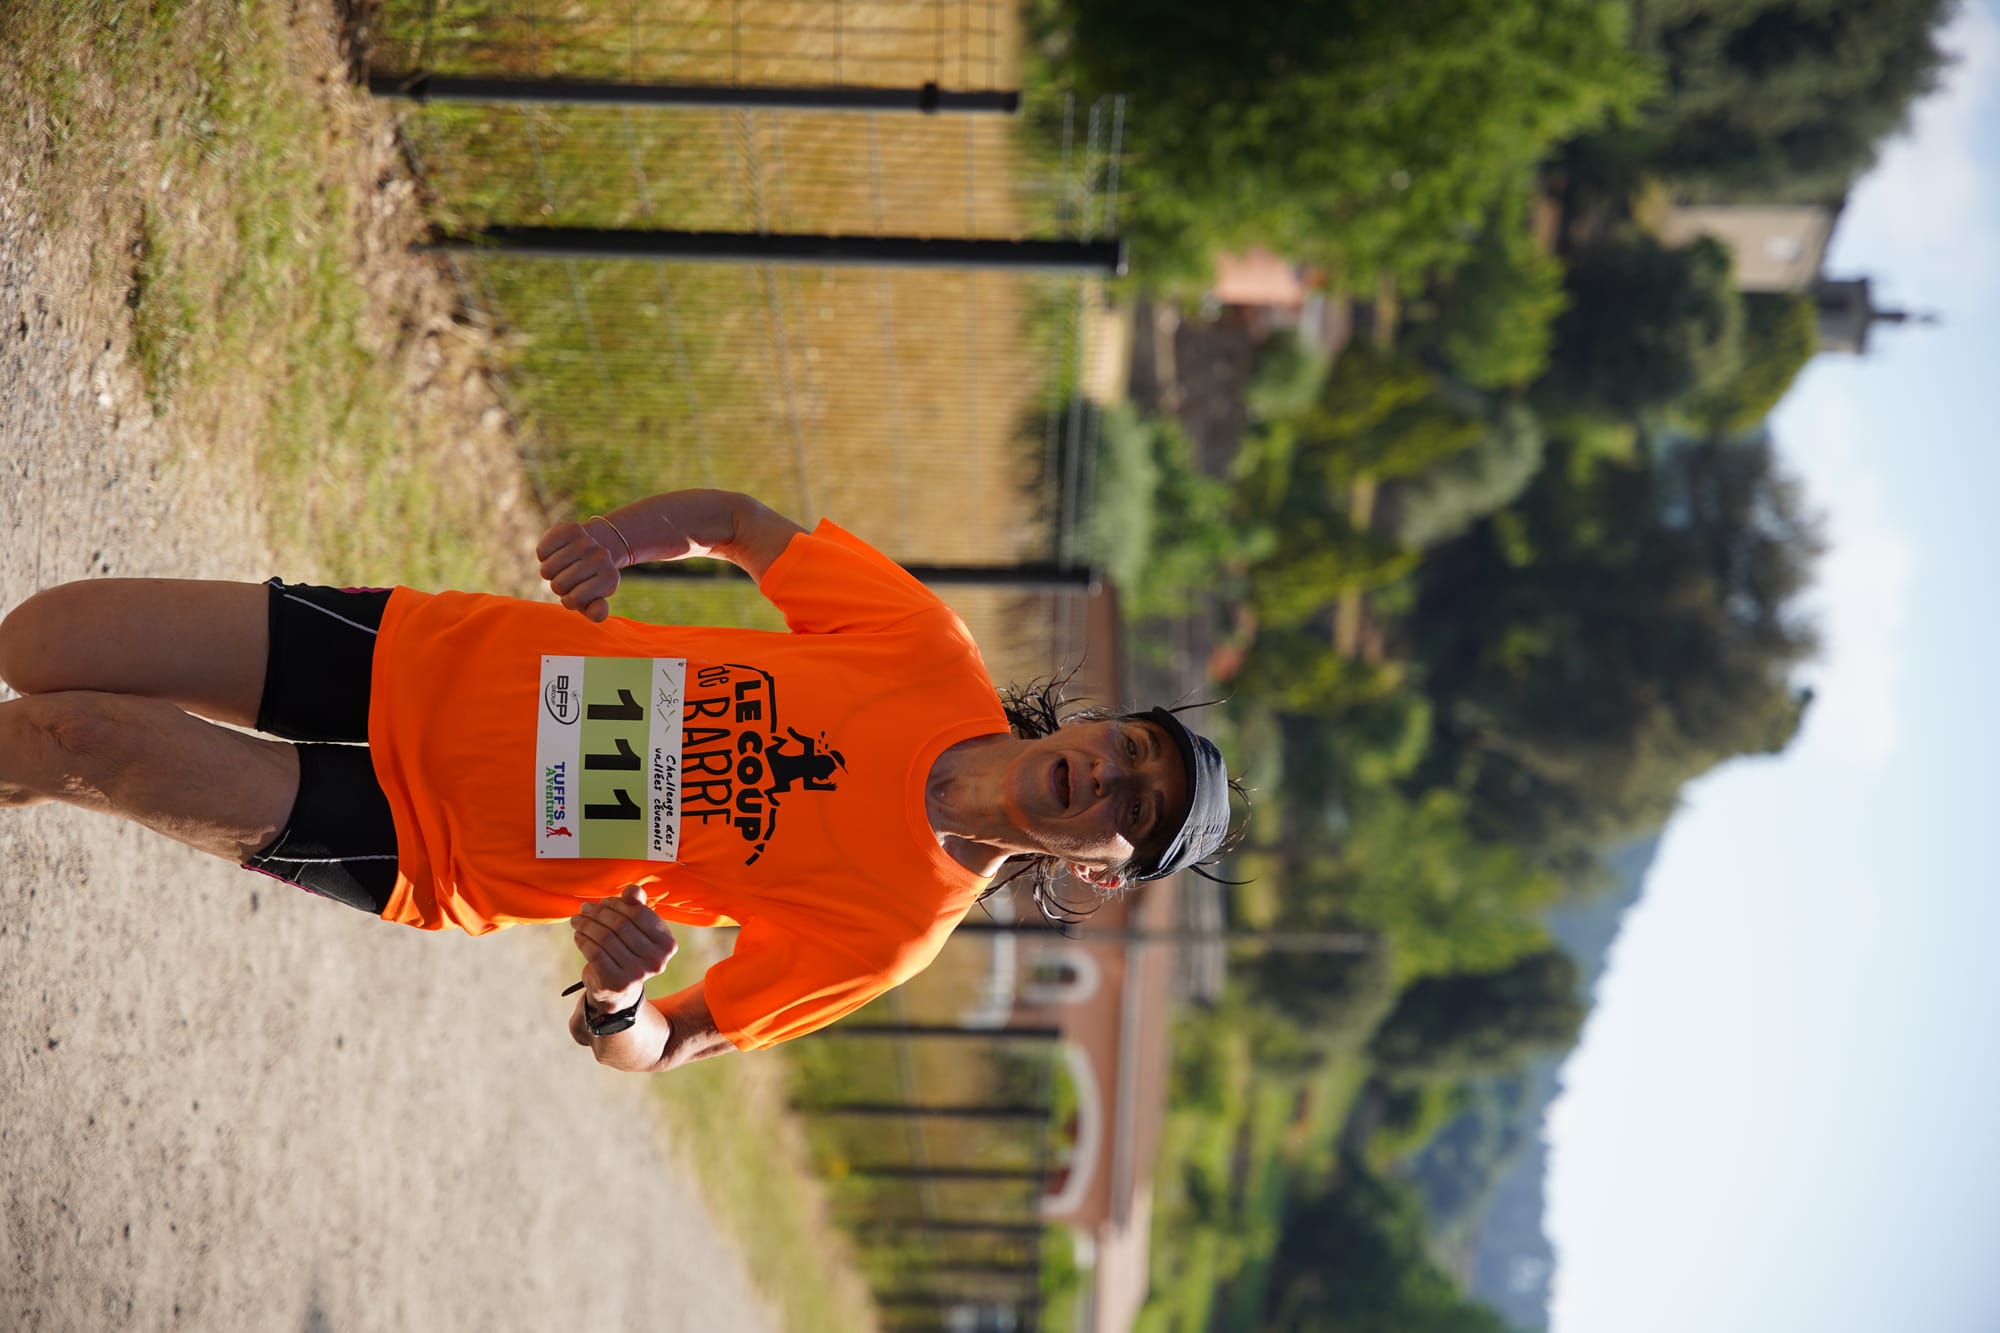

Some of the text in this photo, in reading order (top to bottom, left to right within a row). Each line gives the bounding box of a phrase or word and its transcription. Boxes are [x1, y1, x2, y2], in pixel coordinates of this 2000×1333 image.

[556, 675, 569, 718] BFP
[698, 666, 731, 688] de
[735, 679, 761, 723] LE
[584, 688, 644, 821] 111
[546, 766, 557, 826] Aventure
[554, 761, 565, 820] TUFF'S
[653, 748, 665, 852] vallées cévenoles
[662, 755, 676, 846] Challenge des
